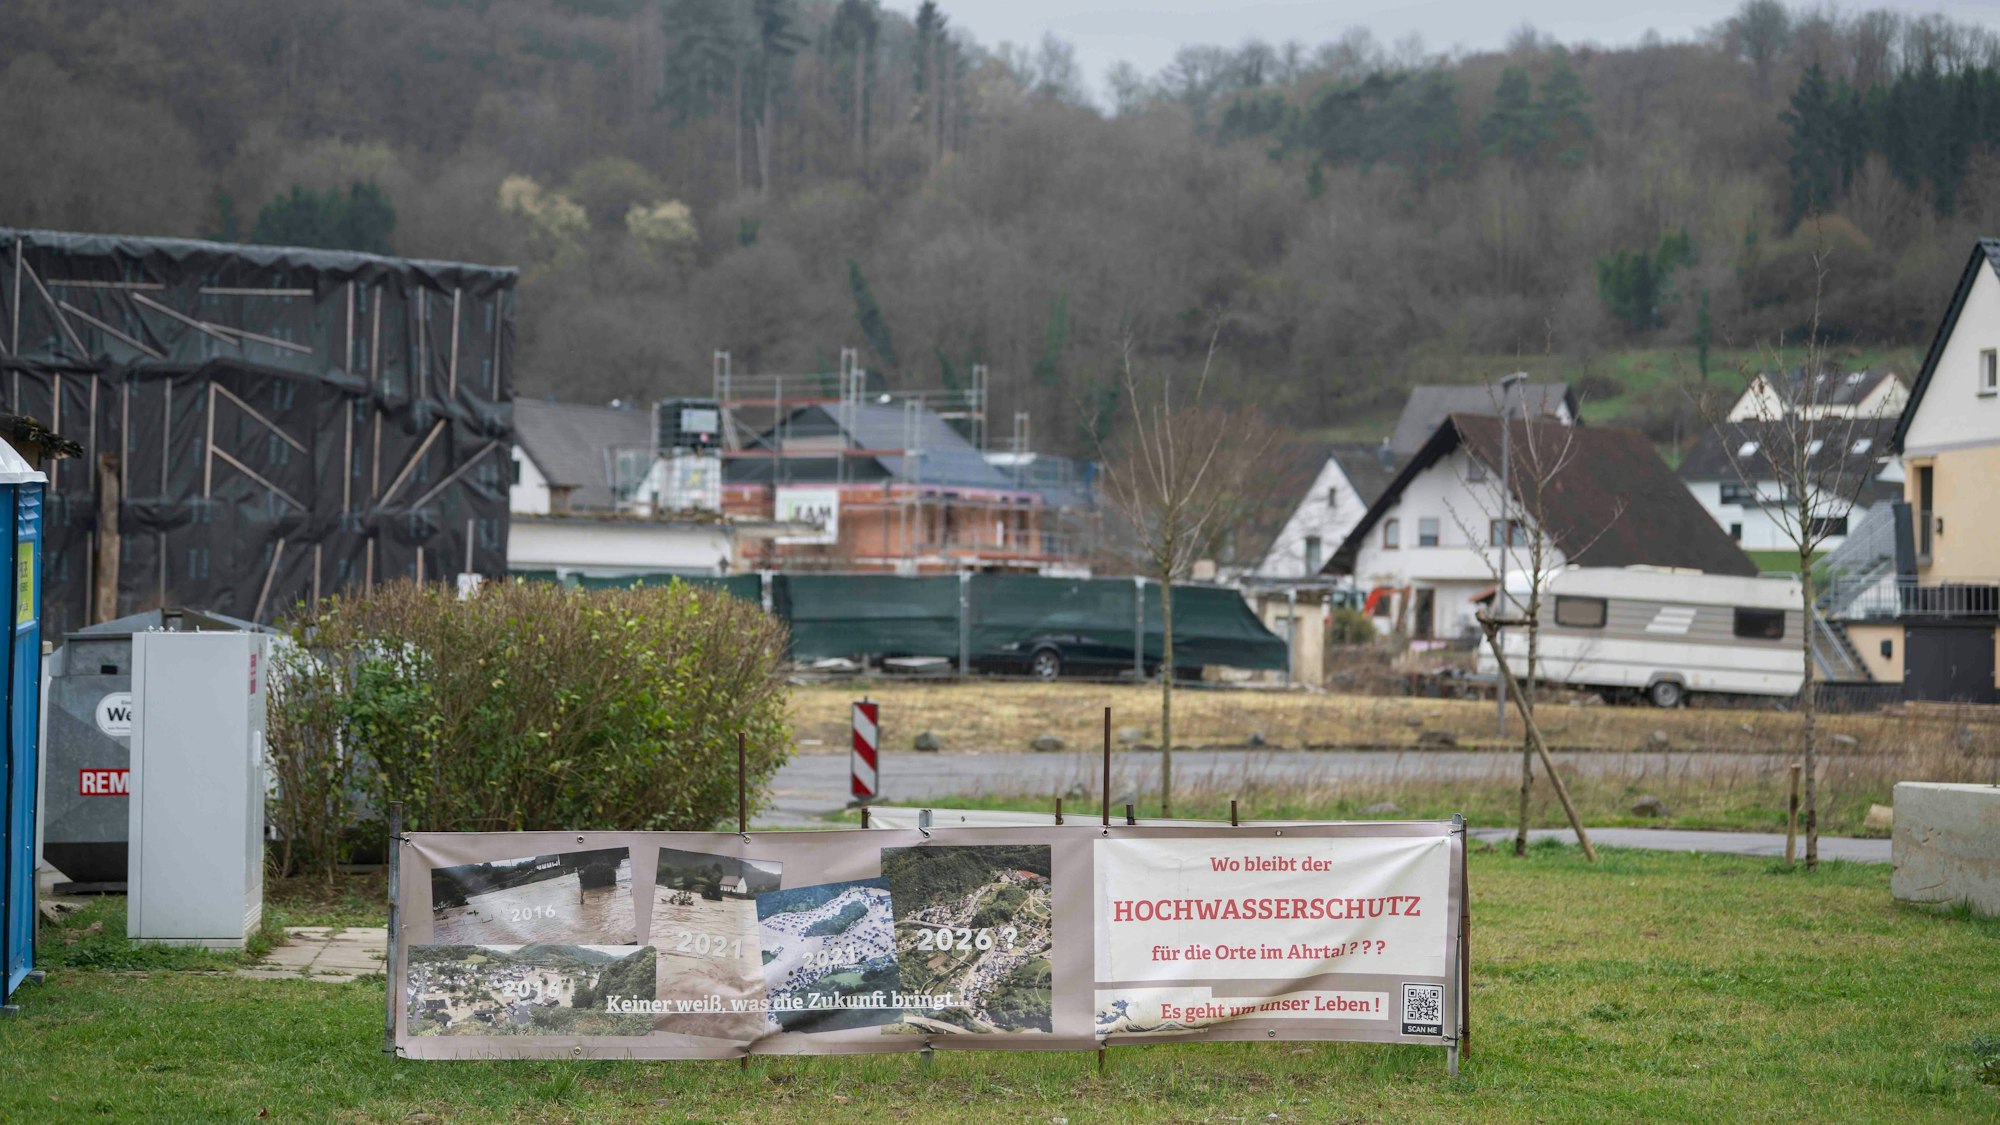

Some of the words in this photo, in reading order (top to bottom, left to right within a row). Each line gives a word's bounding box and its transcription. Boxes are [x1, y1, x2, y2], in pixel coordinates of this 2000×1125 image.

[1210, 856, 1240, 872] Wo
[1244, 856, 1297, 872] bleibt
[1301, 856, 1332, 872] der
[511, 904, 556, 923] 2016
[1113, 896, 1421, 922] HOCHWASSERSCHUTZ
[676, 930, 743, 960] 2021
[916, 927, 993, 952] 2026
[802, 944, 857, 970] 2021
[1151, 945, 1180, 962] für
[1183, 944, 1211, 960] die
[1215, 944, 1256, 960] Orte
[1260, 944, 1283, 960] im
[605, 994, 673, 1013] Keiner
[676, 994, 726, 1014] weiß,
[731, 998, 769, 1012] was
[773, 992, 804, 1010] die
[808, 990, 887, 1009] Zukunft
[1161, 1003, 1181, 1020] Es
[1185, 1002, 1225, 1022] geht
[1230, 1005, 1256, 1018] um
[1259, 998, 1310, 1012] unser
[1314, 996, 1371, 1012] Leben
[1427, 1026, 1438, 1034] ME
